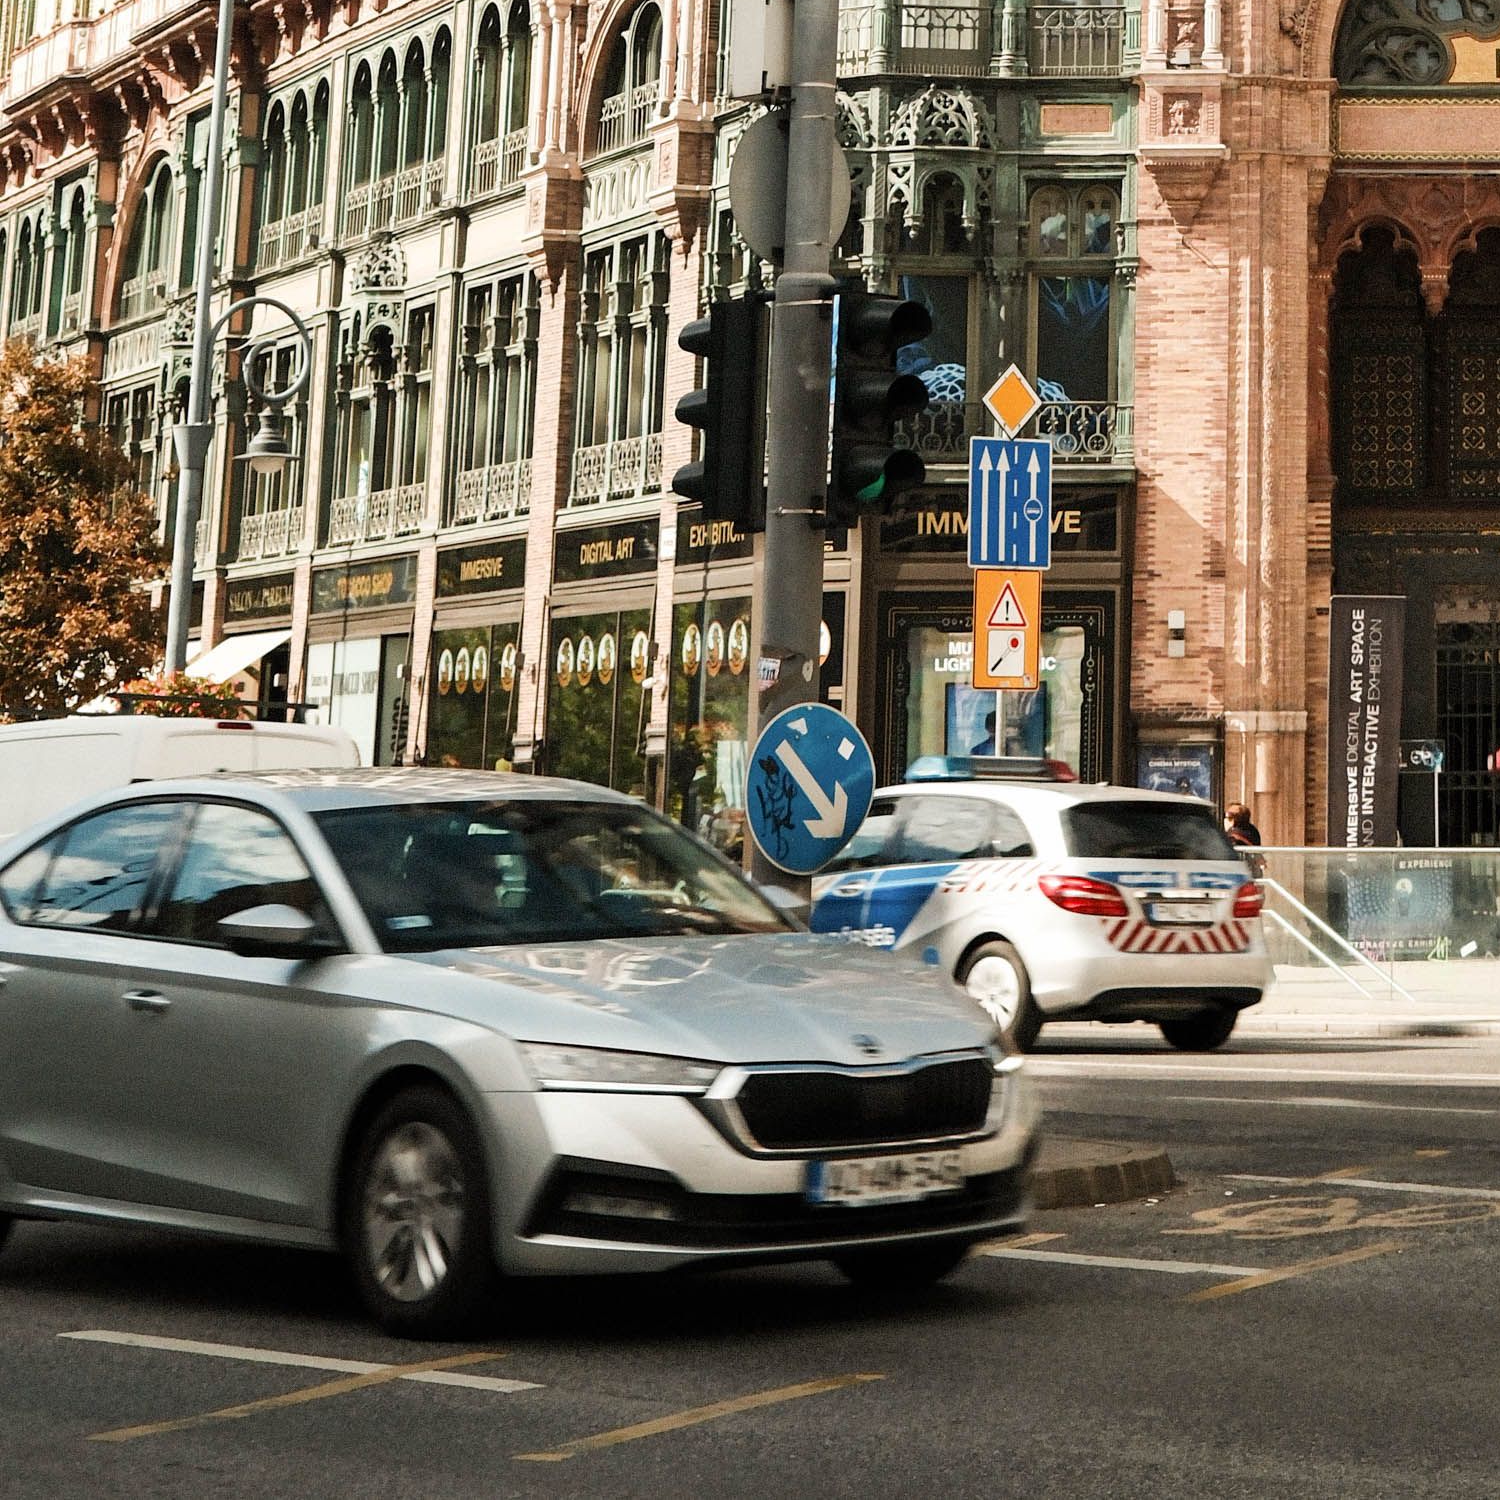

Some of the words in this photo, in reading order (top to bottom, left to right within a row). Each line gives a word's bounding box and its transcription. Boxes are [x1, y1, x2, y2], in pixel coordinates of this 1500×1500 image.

[917, 510, 1081, 535] IMMVE
[460, 556, 503, 581] IMMERSIVE
[579, 540, 614, 565] DIGITAL
[615, 537, 635, 560] ART
[1351, 608, 1365, 666] SPACE
[934, 657, 974, 672] LIGH
[1367, 618, 1383, 702] EXHIBITION
[1350, 669, 1363, 704] ART
[1346, 706, 1361, 763] DIGITAL
[1361, 704, 1380, 816] INTERACTIVE
